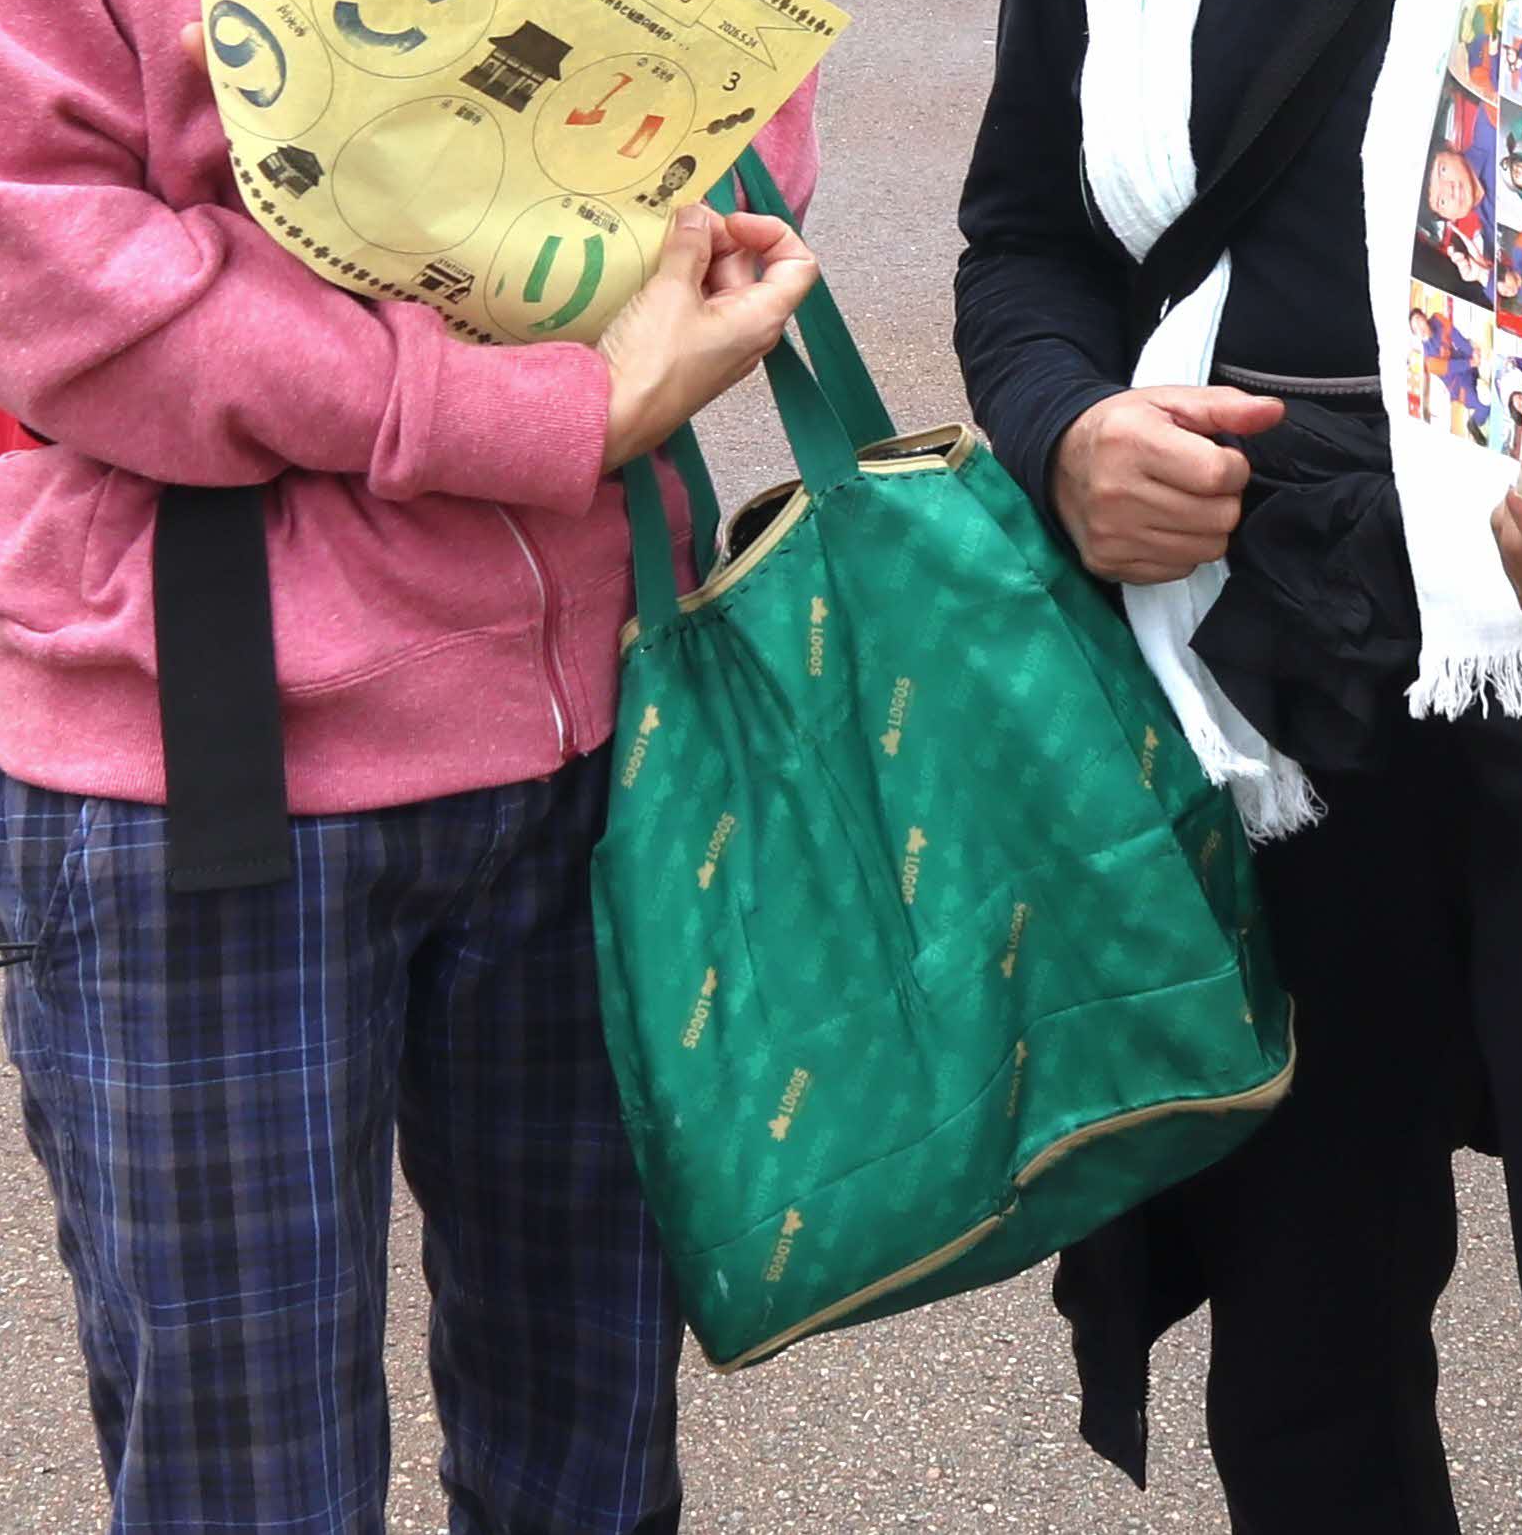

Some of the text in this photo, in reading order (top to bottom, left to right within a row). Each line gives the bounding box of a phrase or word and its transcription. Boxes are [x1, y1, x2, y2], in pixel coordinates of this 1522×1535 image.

[717, 19, 759, 50] 2026.5.24
[721, 71, 741, 92] 3
[809, 625, 825, 677] LOGOS
[889, 676, 913, 730] LOGOS
[622, 736, 651, 788] LOGOS
[707, 811, 737, 862] LOGOS
[682, 998, 712, 1050] LOGOS
[778, 1066, 811, 1114] LOGOS
